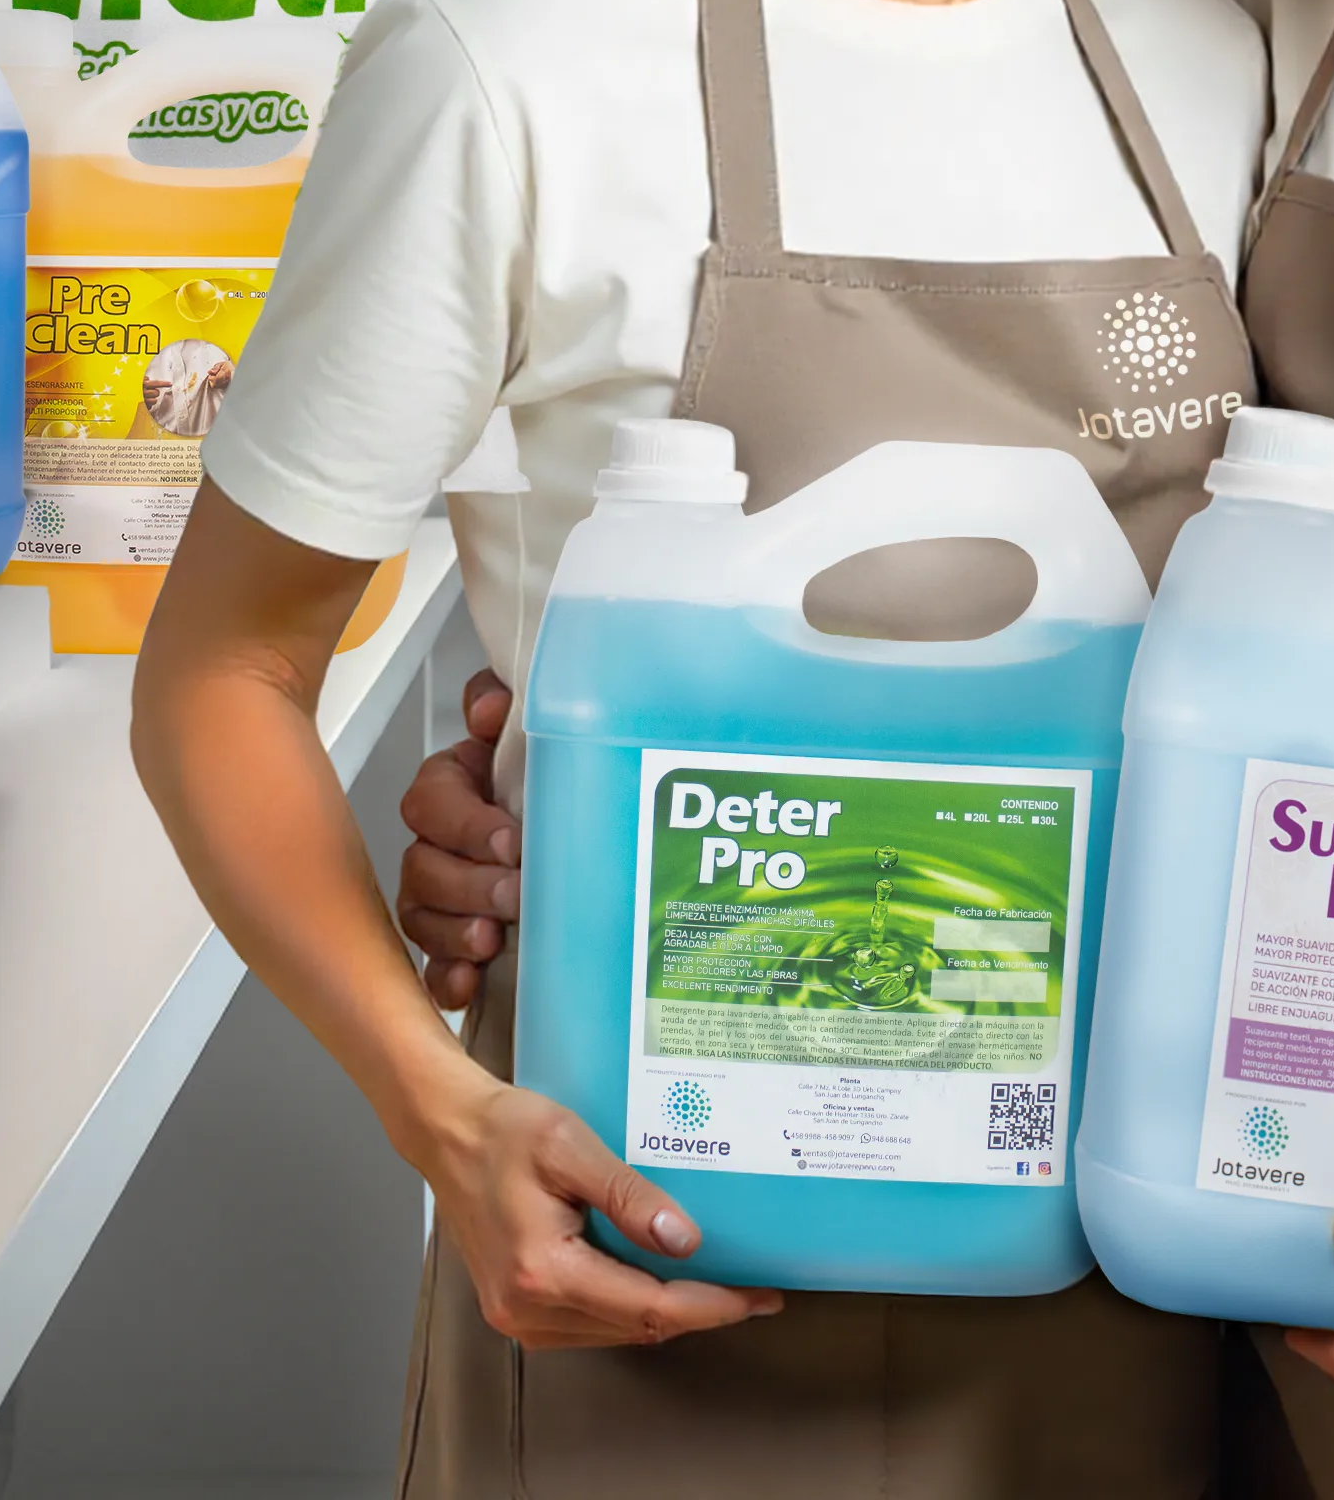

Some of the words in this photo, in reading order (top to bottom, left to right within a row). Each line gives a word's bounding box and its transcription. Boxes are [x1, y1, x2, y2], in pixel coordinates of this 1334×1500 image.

[49, 276, 131, 315] Pre
[25, 314, 161, 355] Clean
[1078, 390, 1243, 441] Jotavere
[668, 781, 842, 837] Deter
[945, 812, 956, 822] 4L
[973, 813, 991, 823] 20L
[1006, 814, 1024, 824] 25L
[1040, 816, 1058, 826] 30L
[1001, 799, 1059, 812] CONTENIDO
[698, 835, 807, 890] Pro
[1256, 932, 1293, 950] MAYOR
[662, 980, 712, 993] EXCELENTE
[713, 983, 773, 995] RENDIMIENTO
[1248, 1001, 1278, 1017] LIBRE
[639, 1131, 731, 1156] Jotavere
[1212, 1157, 1306, 1187] Jotavere
